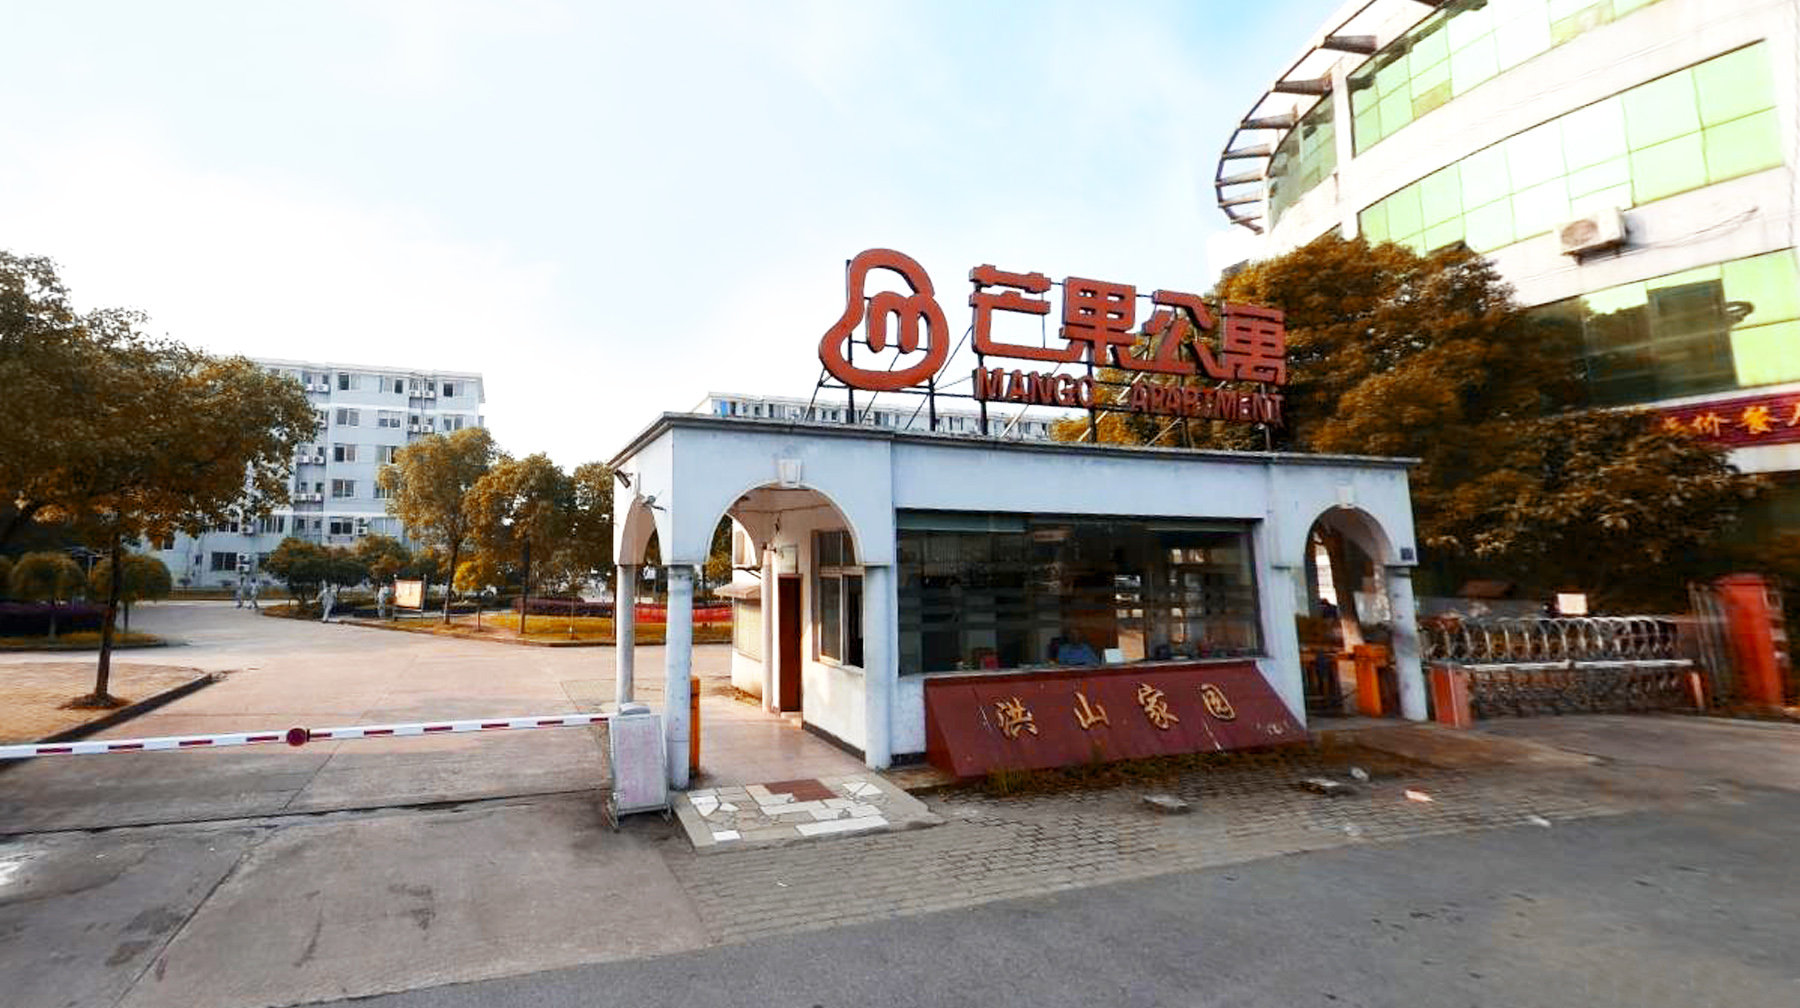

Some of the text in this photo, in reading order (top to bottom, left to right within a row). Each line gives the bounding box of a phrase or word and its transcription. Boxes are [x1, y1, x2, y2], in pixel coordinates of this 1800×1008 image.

[969, 264, 1286, 386] 芒果公寓
[972, 367, 1285, 424] MANGO APARTMENT
[996, 683, 1236, 739] 洪山家园
